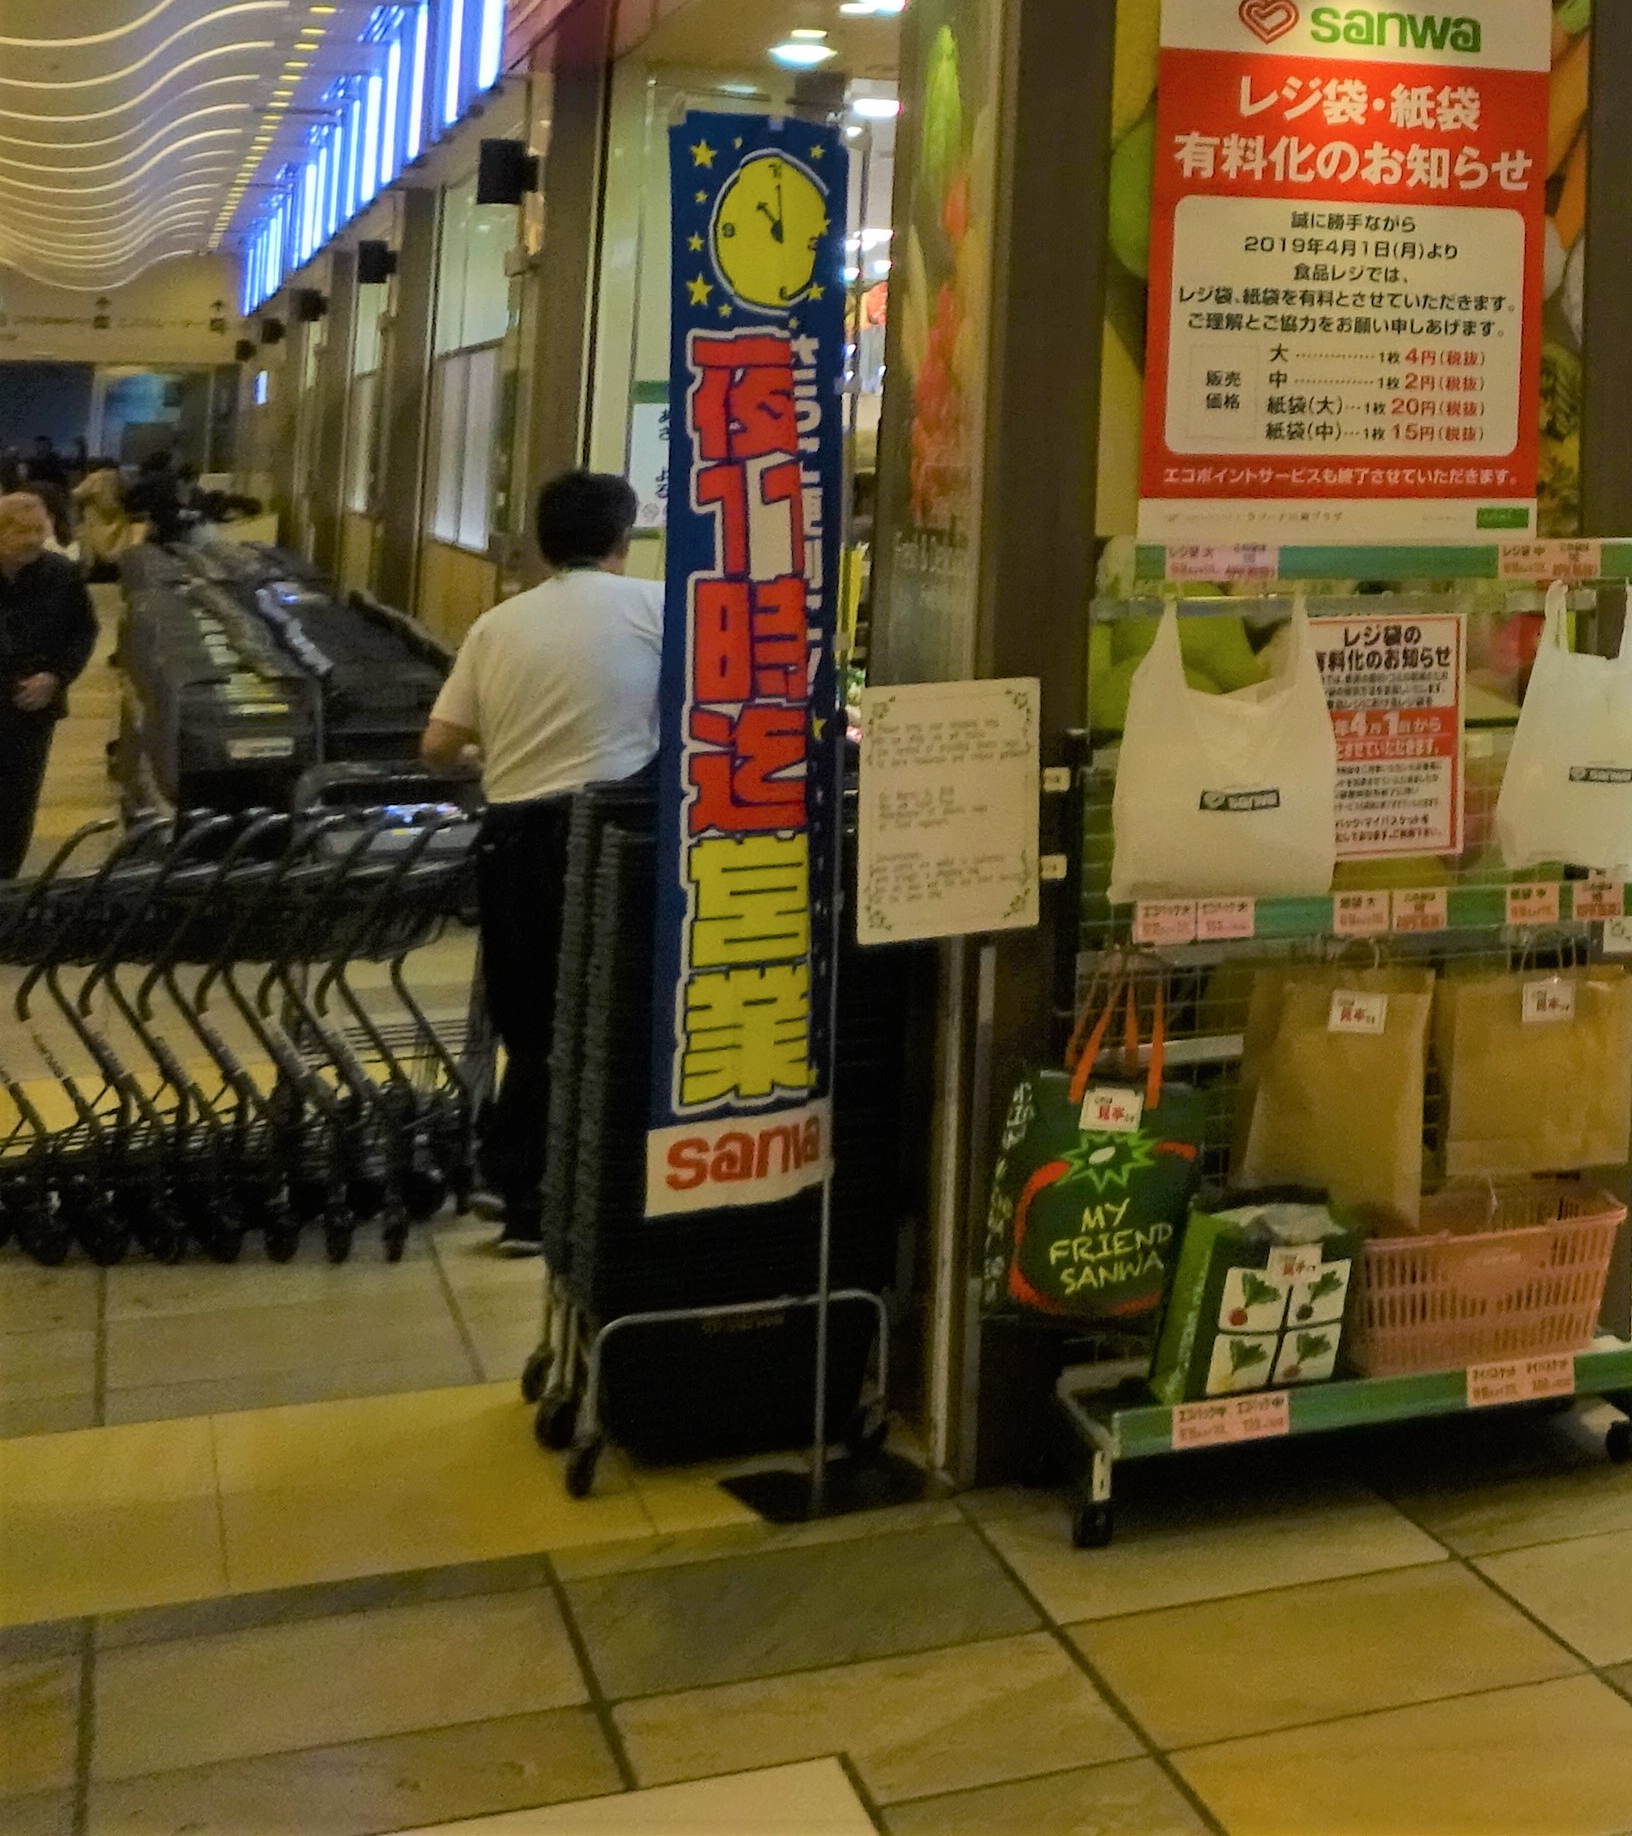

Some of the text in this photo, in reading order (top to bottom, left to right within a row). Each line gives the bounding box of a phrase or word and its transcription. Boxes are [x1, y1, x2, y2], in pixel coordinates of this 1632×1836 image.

[1310, 6, 1482, 54] sanwa
[1239, 75, 1482, 133] レジ袋・紙袋
[1173, 131, 1533, 192] 有料化のお知らせ
[1290, 211, 1416, 233] 誠に勝手ながら
[1343, 624, 1422, 647] レジ袋の
[1081, 1197, 1131, 1233] MY
[1048, 1221, 1174, 1266] FRIEND
[1059, 1249, 1165, 1296] SANWA
